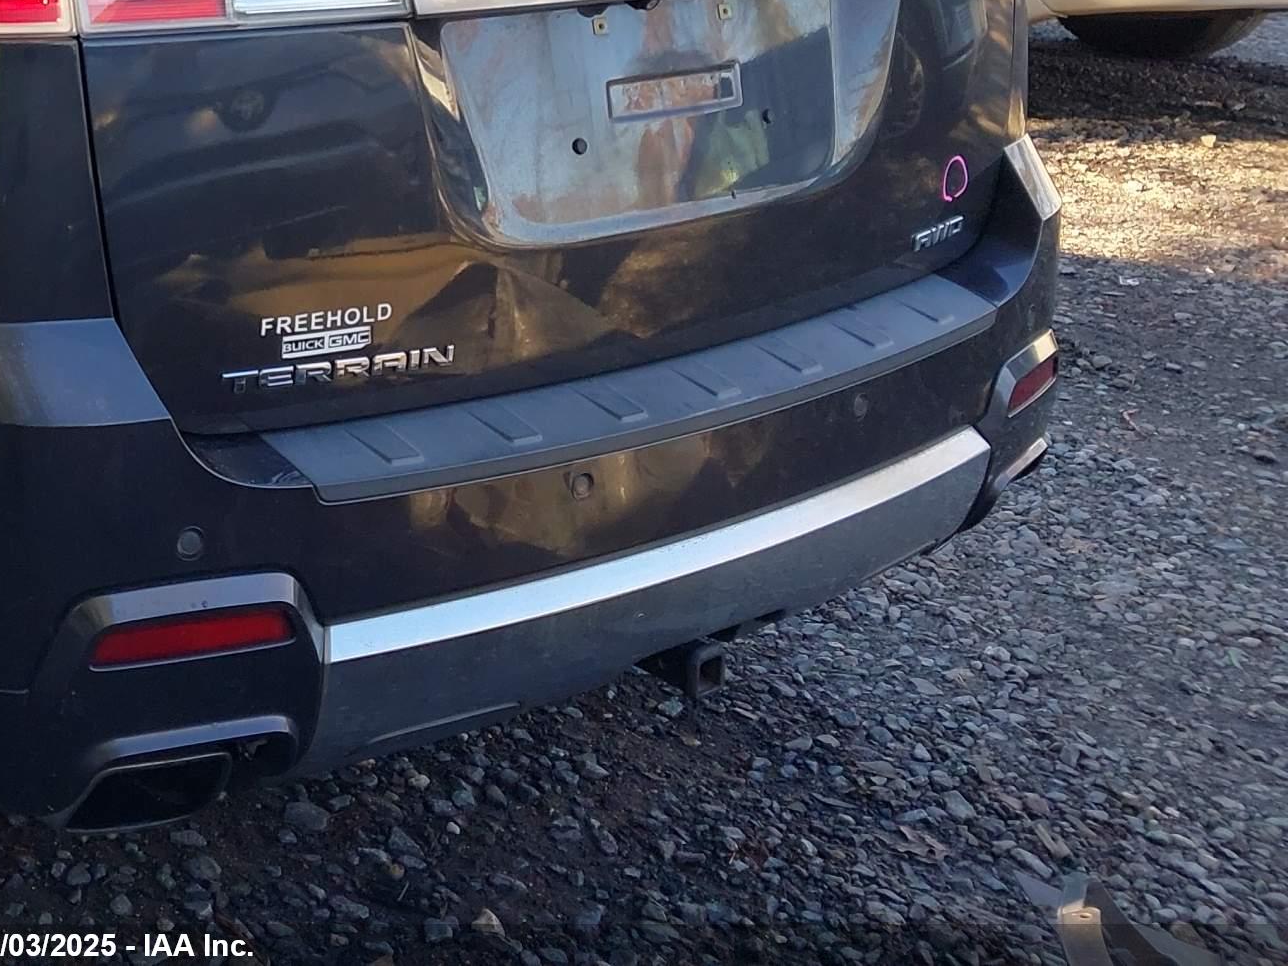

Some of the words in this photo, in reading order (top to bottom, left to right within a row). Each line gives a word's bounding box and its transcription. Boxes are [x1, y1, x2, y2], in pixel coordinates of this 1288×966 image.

[261, 303, 392, 335] FREEHOLD
[283, 338, 324, 354] BUICK
[329, 332, 369, 348] GMC
[222, 345, 454, 394] TERRAIN
